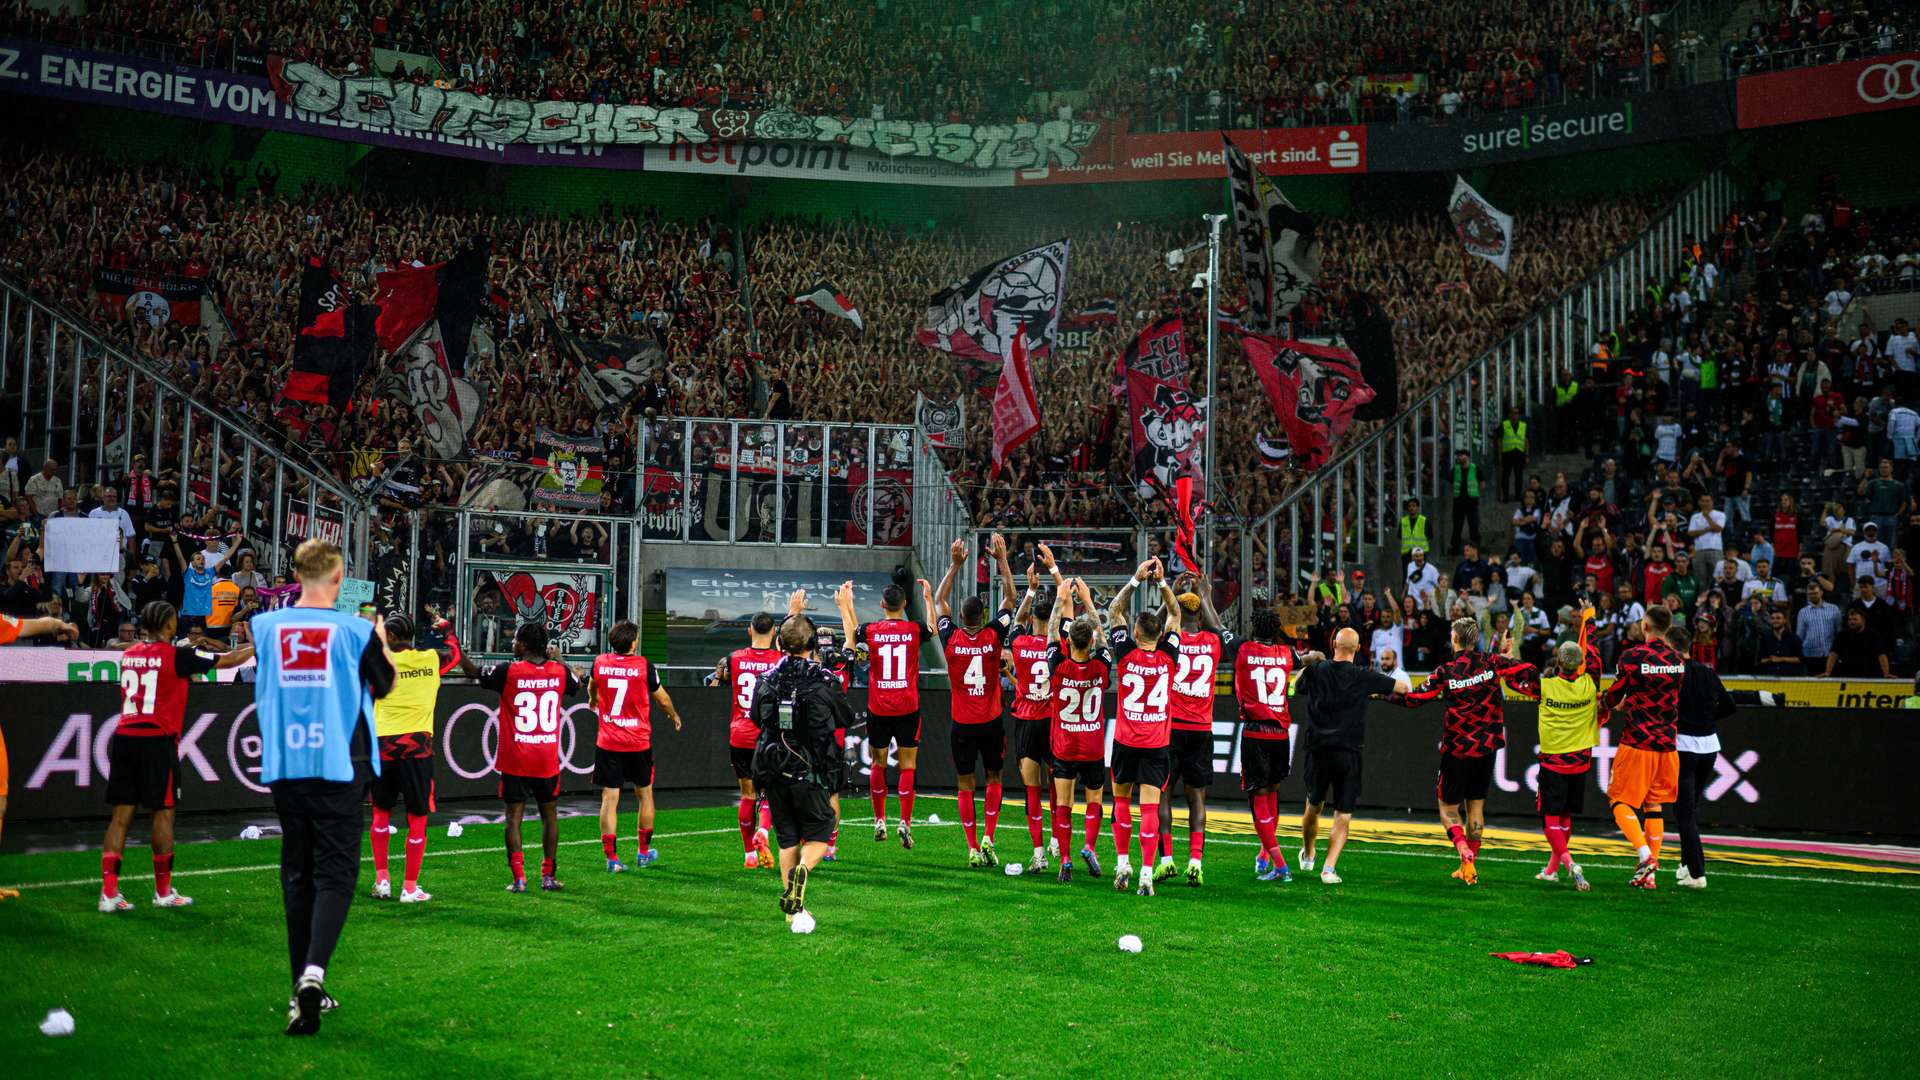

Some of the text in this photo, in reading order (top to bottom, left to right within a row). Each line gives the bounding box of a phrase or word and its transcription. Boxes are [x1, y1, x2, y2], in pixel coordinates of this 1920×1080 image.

[40, 54, 196, 105] ENERGIE
[205, 78, 276, 117] VOM
[281, 60, 704, 147] DEUTSCHER
[813, 113, 1081, 171] MEISTER
[1131, 152, 1163, 169] weil
[1167, 151, 1193, 167] Sie
[1281, 145, 1321, 163] sind.
[702, 589, 751, 598] die
[874, 633, 912, 643] BAYER 04
[1200, 644, 1212, 654] 04
[955, 644, 993, 655] BAYER 04
[148, 657, 162, 667] 04
[599, 666, 639, 676] BAYER 04
[739, 661, 767, 671] BAYER
[878, 644, 907, 680] 11
[1126, 662, 1168, 675] BAYER 04
[1247, 656, 1288, 666] BAYER 04
[517, 678, 560, 689] BAYER 04
[963, 656, 986, 689] 4
[1029, 660, 1051, 697] 3
[1062, 677, 1103, 687] BAYER 04
[1173, 654, 1213, 693] 22
[1448, 670, 1494, 690] Barmenia
[121, 669, 159, 716] 21
[877, 680, 908, 689] TERRIER
[968, 688, 984, 696] TAH
[1122, 673, 1169, 713] 24
[1250, 666, 1286, 706] 12
[607, 678, 628, 716] 7
[1059, 687, 1102, 722] 20
[514, 690, 559, 733] 30
[286, 722, 325, 750] 05
